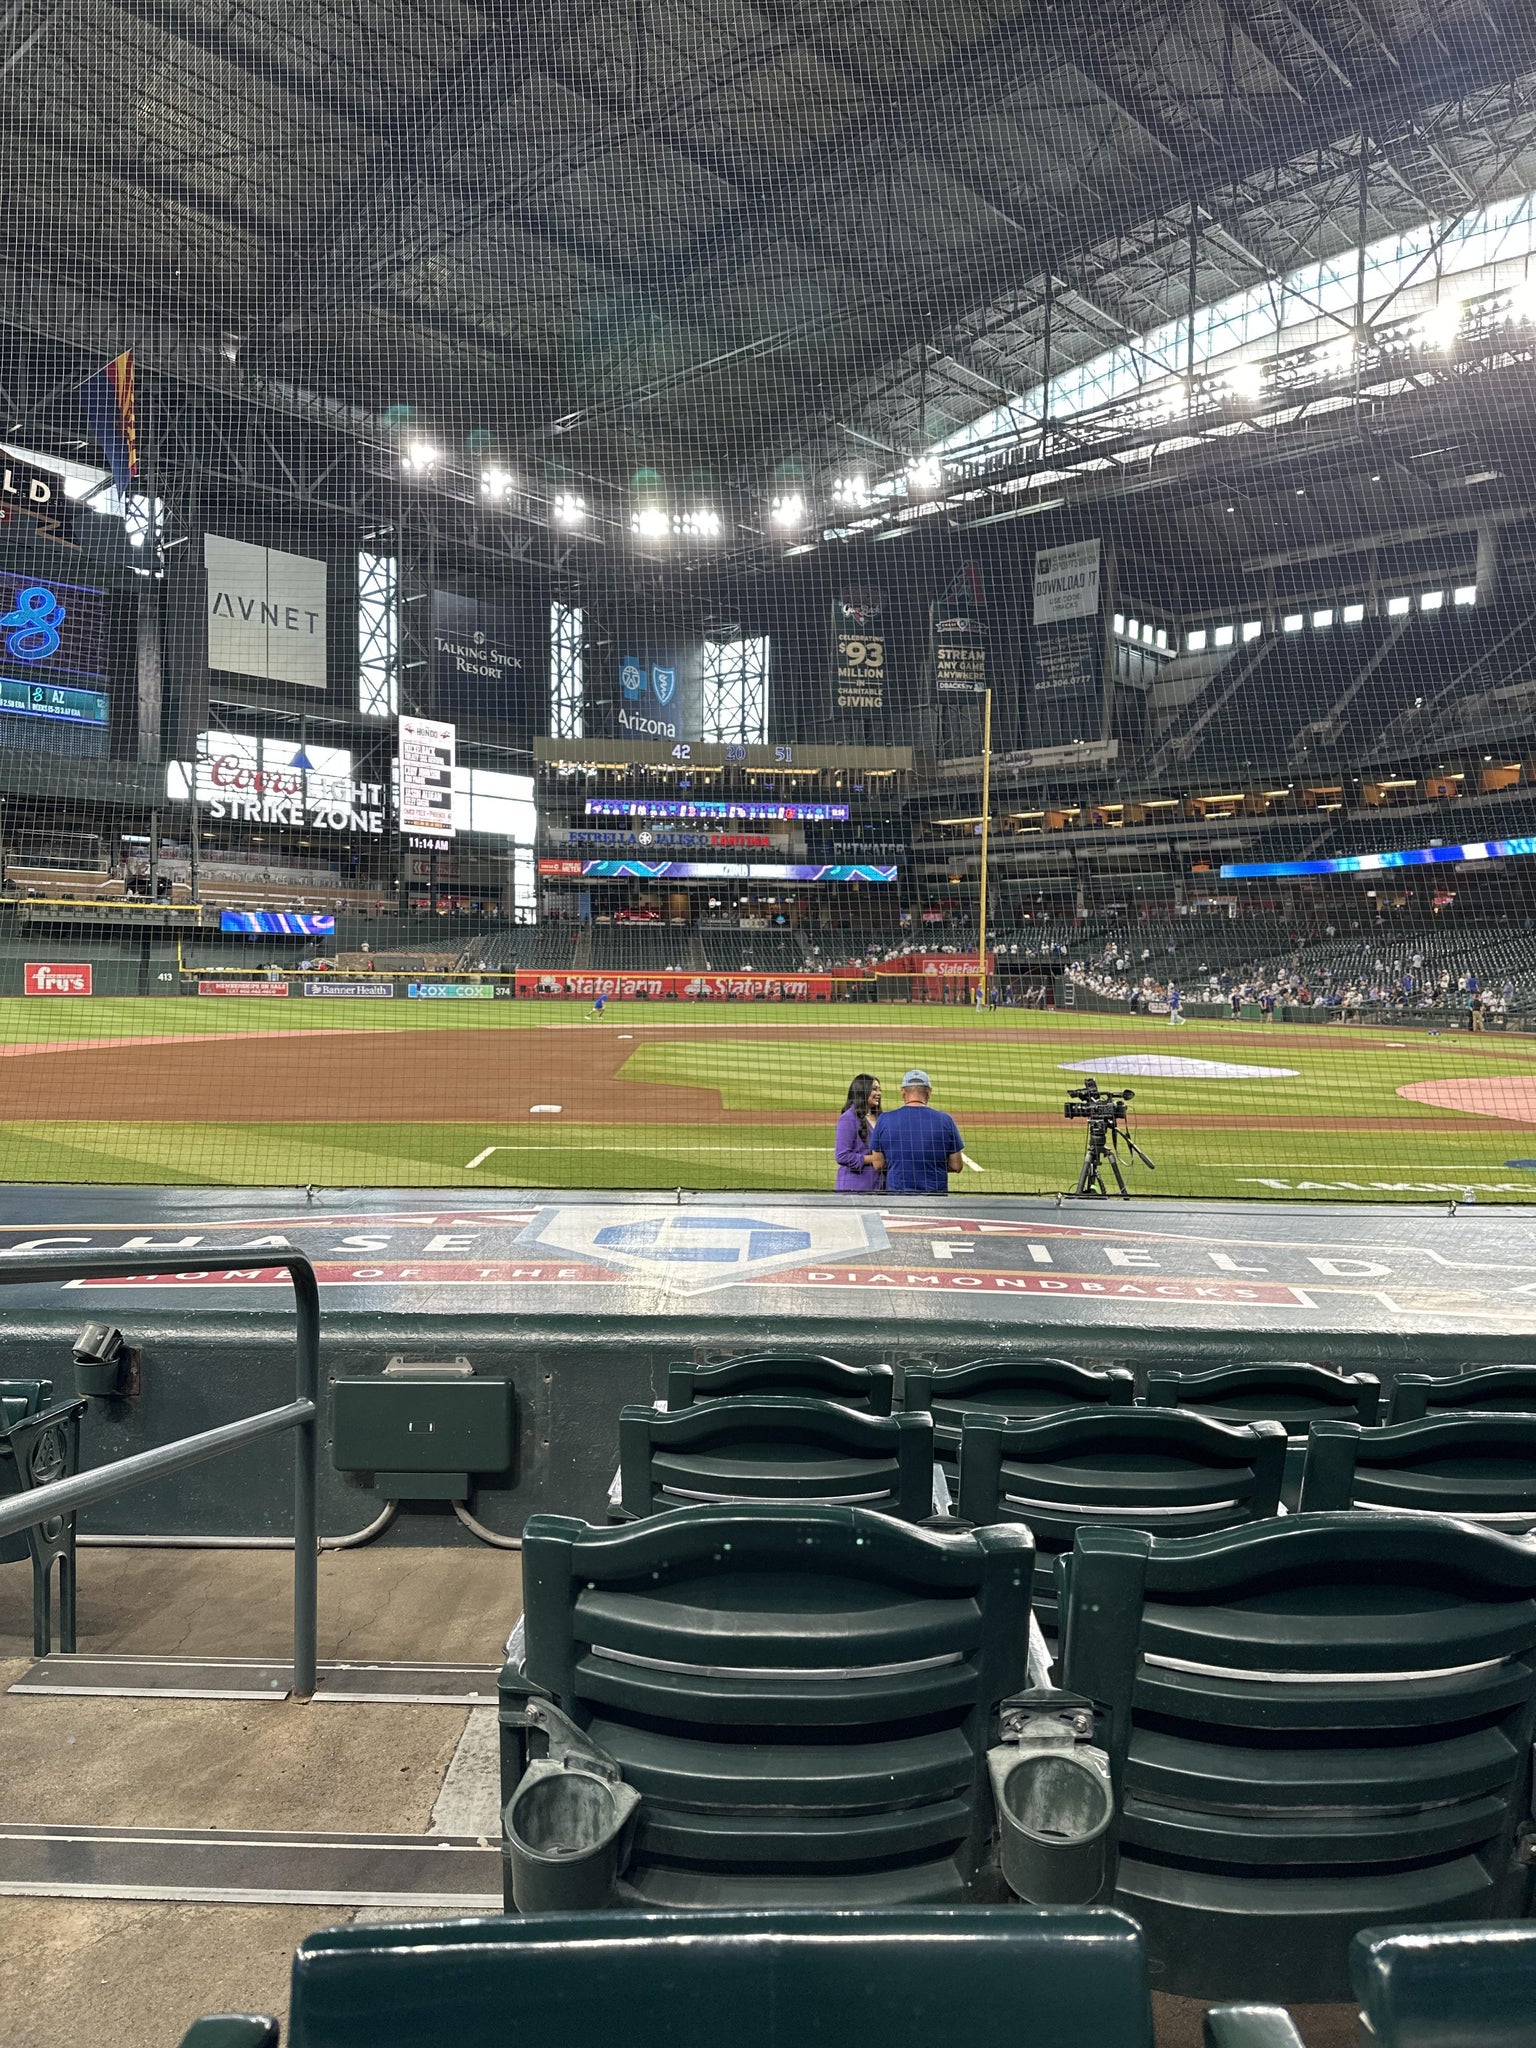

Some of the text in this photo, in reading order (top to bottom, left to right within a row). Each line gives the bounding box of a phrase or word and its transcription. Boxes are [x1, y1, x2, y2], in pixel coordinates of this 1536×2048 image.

[1036, 570, 1097, 597] DOWNLOAD IT
[212, 592, 319, 634] AVNET
[838, 634, 885, 642] CELEBRATING
[434, 637, 522, 669] TALKING STICK
[838, 641, 884, 667] $93
[937, 649, 985, 661] STREAM
[456, 657, 503, 679] RESORT
[838, 668, 884, 679] MILLION
[937, 661, 985, 671] ANY GAME
[937, 671, 985, 680] ANYWHERE
[51, 689, 65, 704] AZ
[838, 687, 883, 696] CHARITABLE
[838, 696, 883, 708] GIVING
[618, 709, 676, 738] Arizona
[672, 744, 691, 759] 42
[725, 746, 746, 760] 20
[775, 746, 793, 762] 51
[212, 754, 383, 805] Coors LIGHT
[210, 797, 384, 833] STRIKE ZONE
[409, 837, 449, 851] 11:14 AM
[568, 832, 771, 847] ESTRELLA JALISCO CANTINA
[32, 967, 85, 991] fry's
[157, 973, 173, 981] 413
[322, 985, 387, 996] Banner Health
[420, 986, 447, 997] COX
[456, 987, 483, 997] COX
[495, 987, 510, 996] 374
[11, 1235, 1394, 1277] CHASE FIELD
[351, 1269, 421, 1278] OF
[479, 1269, 579, 1277] THE
[807, 1272, 1259, 1298] DIAMONDBACKS
